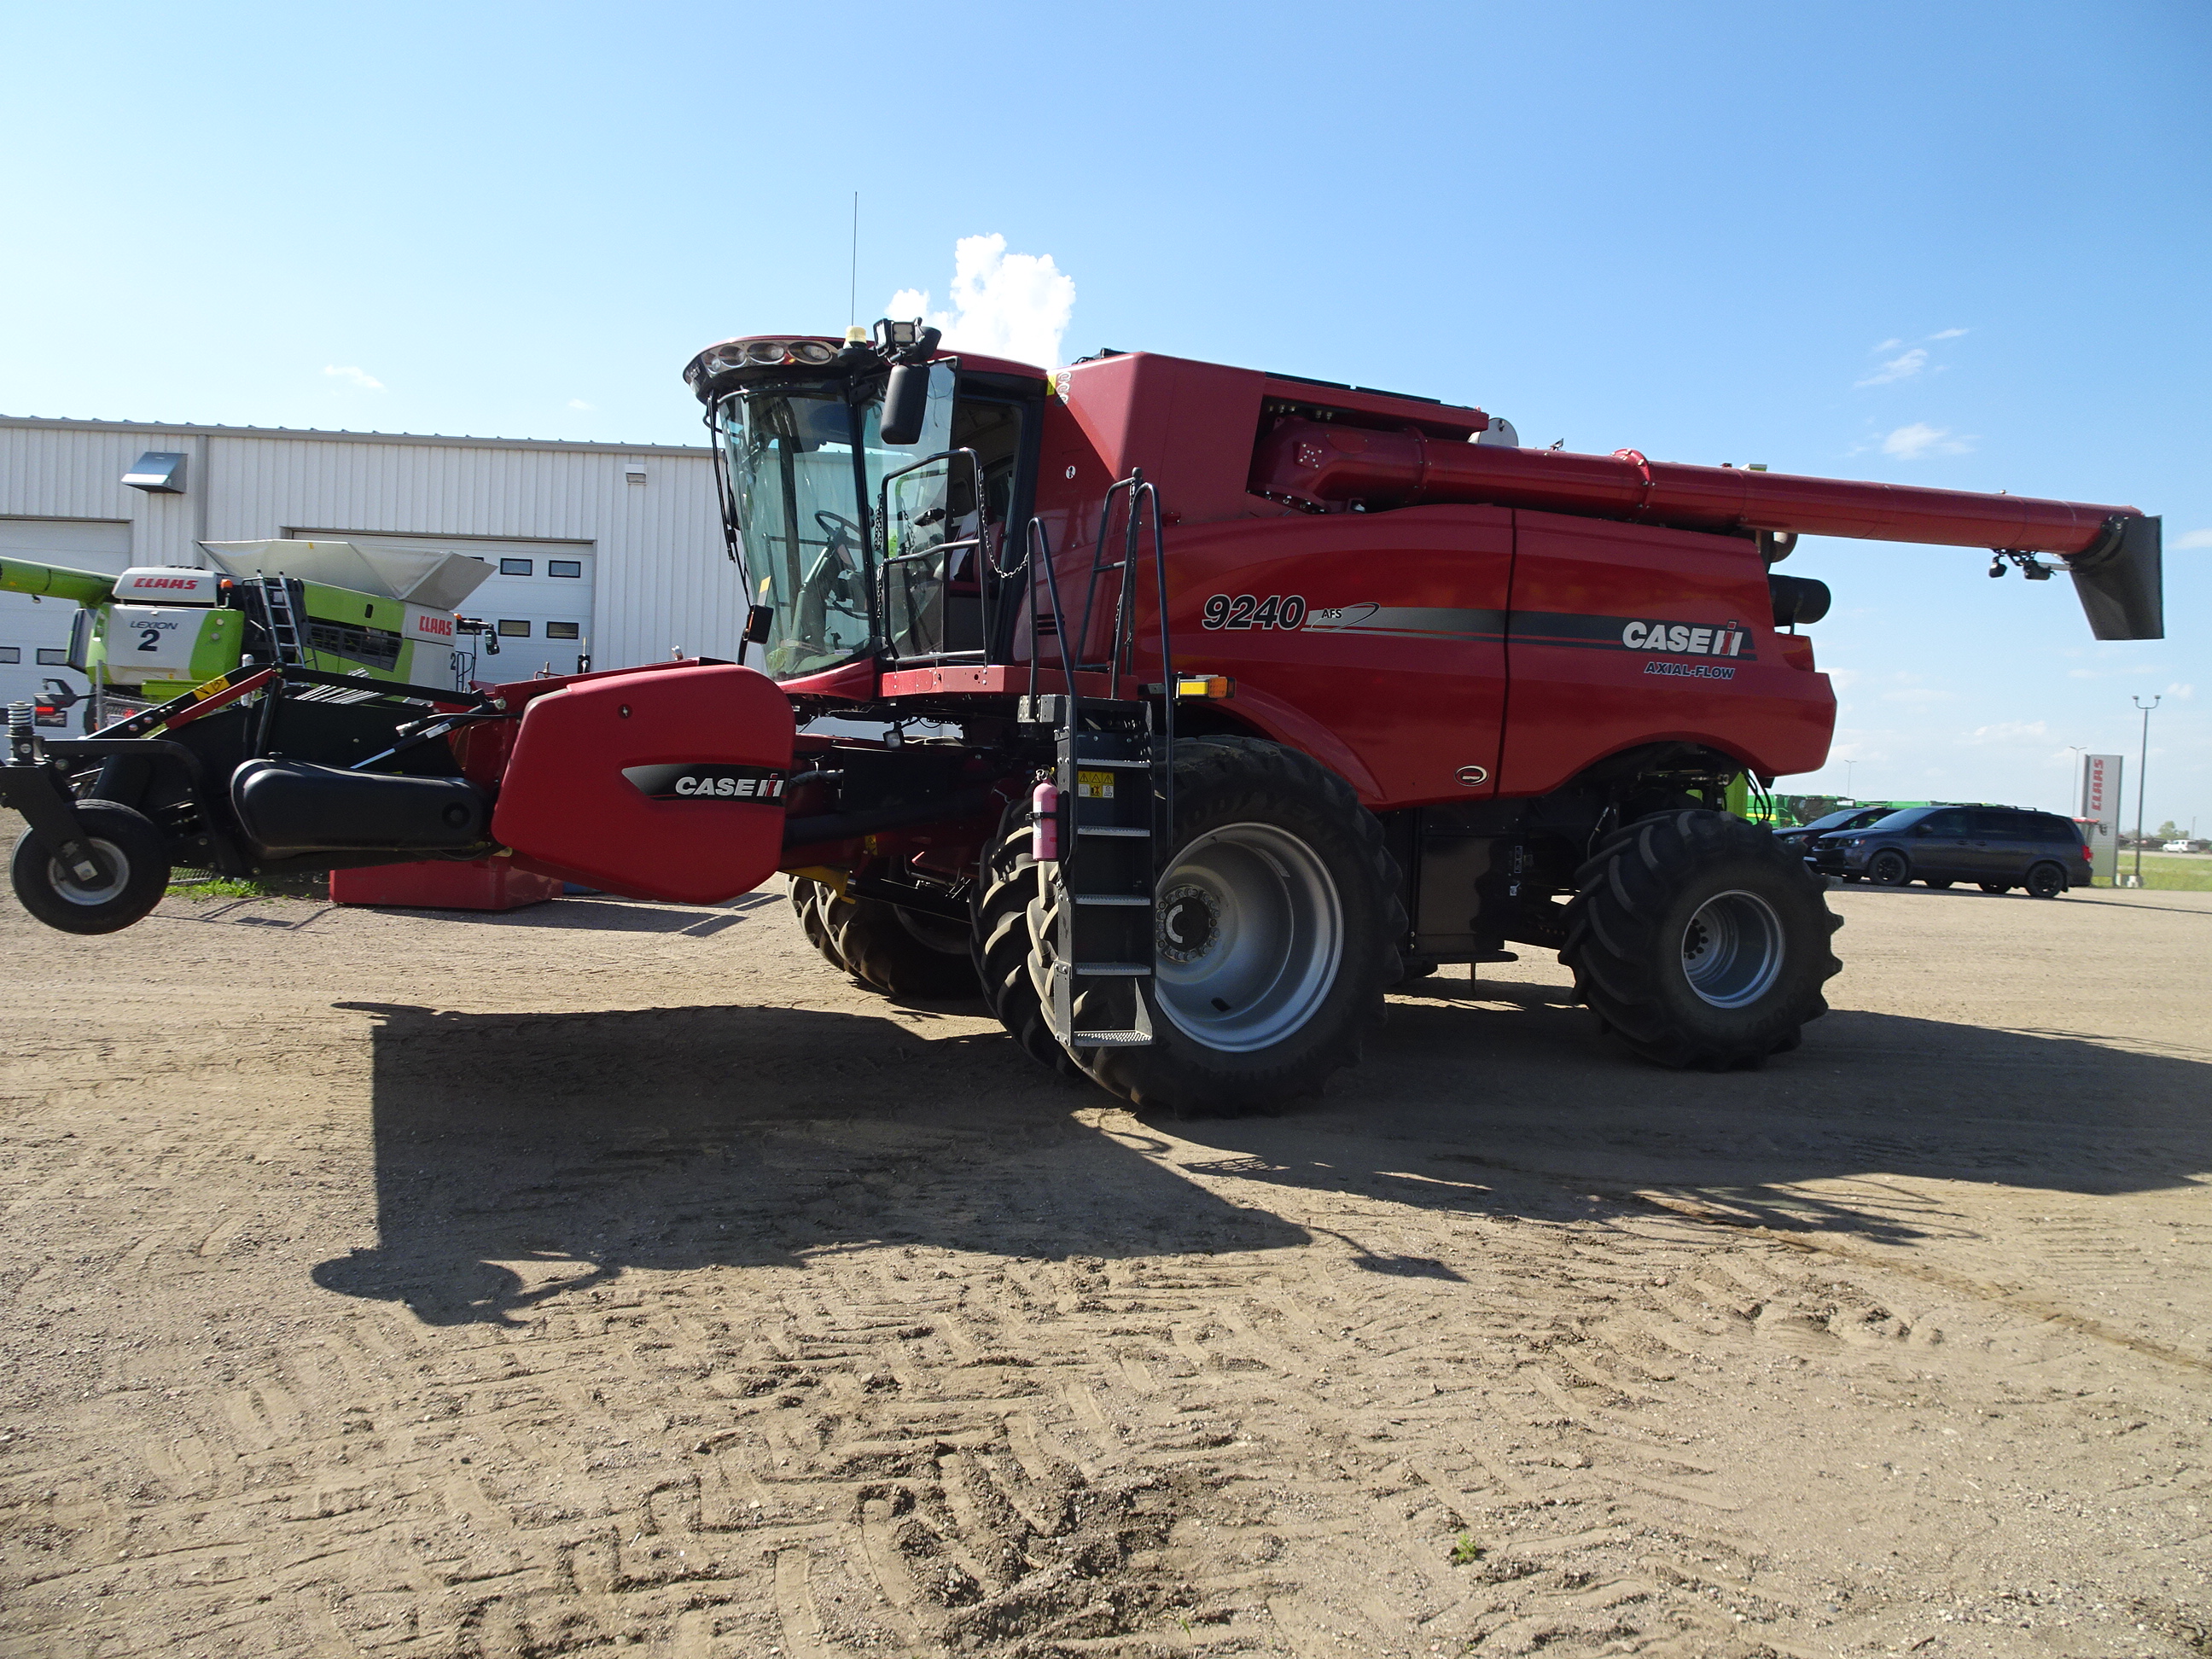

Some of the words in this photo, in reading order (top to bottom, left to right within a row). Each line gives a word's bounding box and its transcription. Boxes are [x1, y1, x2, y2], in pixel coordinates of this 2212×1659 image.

[133, 578, 199, 590] CLAAS
[1202, 594, 1306, 631] 9240
[1321, 608, 1342, 619] AFS
[130, 620, 178, 630] LEXION
[419, 615, 452, 637] CLAAS
[137, 629, 160, 652] 2
[1622, 621, 1712, 654] CASE
[450, 652, 457, 671] 2
[1644, 661, 1736, 680] AXIAL-FLOW
[675, 776, 757, 797] CASE
[2091, 758, 2104, 812] CLAAS
